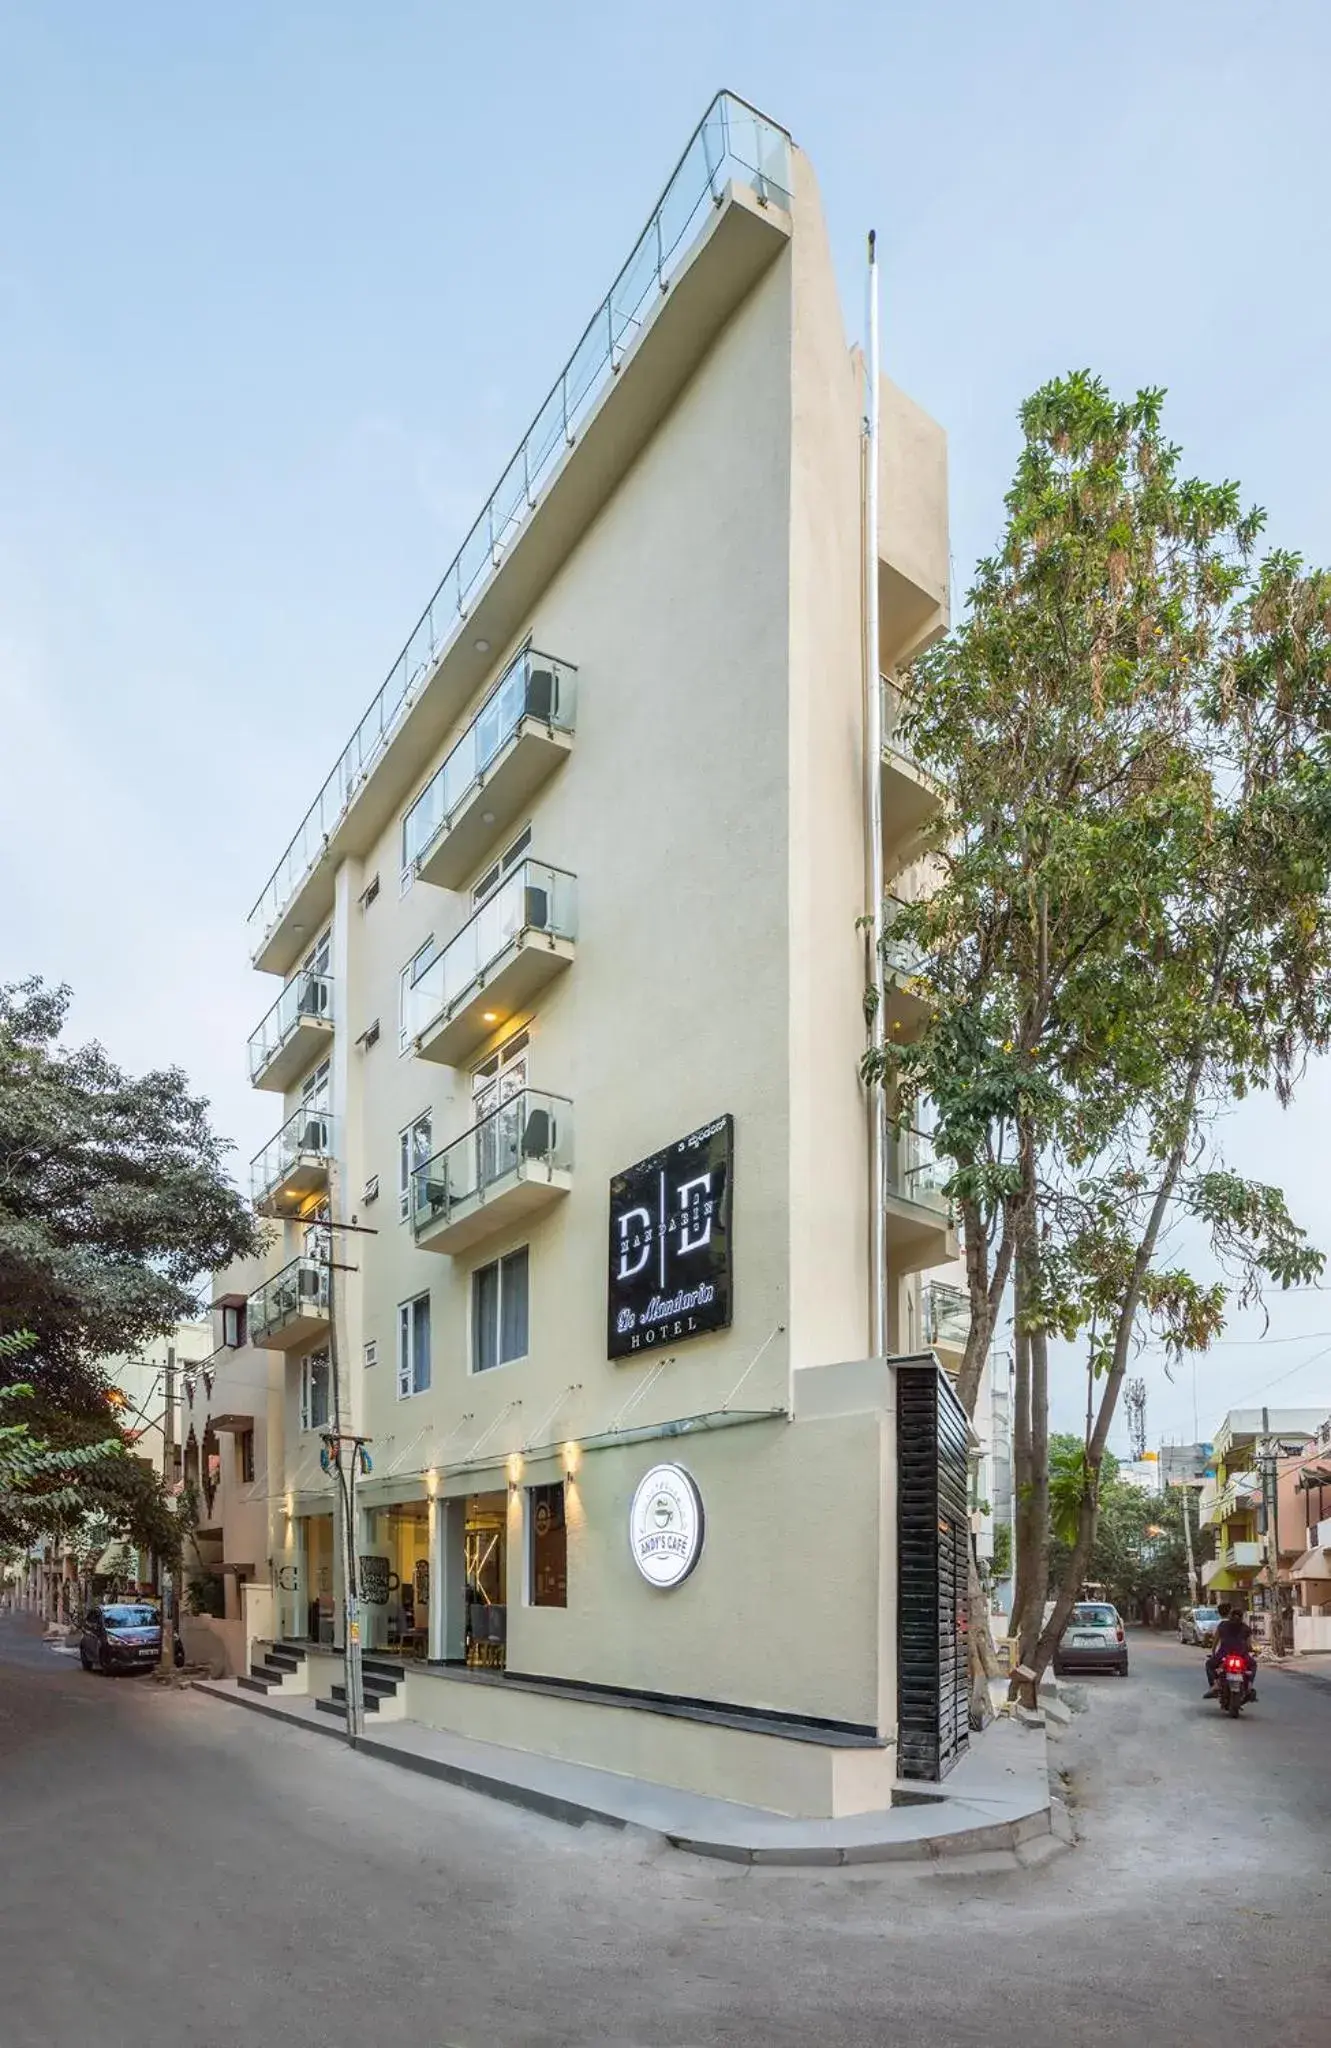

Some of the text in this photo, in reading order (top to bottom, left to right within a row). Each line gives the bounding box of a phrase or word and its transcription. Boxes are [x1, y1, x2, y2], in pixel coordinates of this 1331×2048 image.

[640, 1282, 714, 1325] Mandarin
[631, 1316, 697, 1349] HOTEL
[641, 1535, 688, 1555] ANDY'S CAFE
